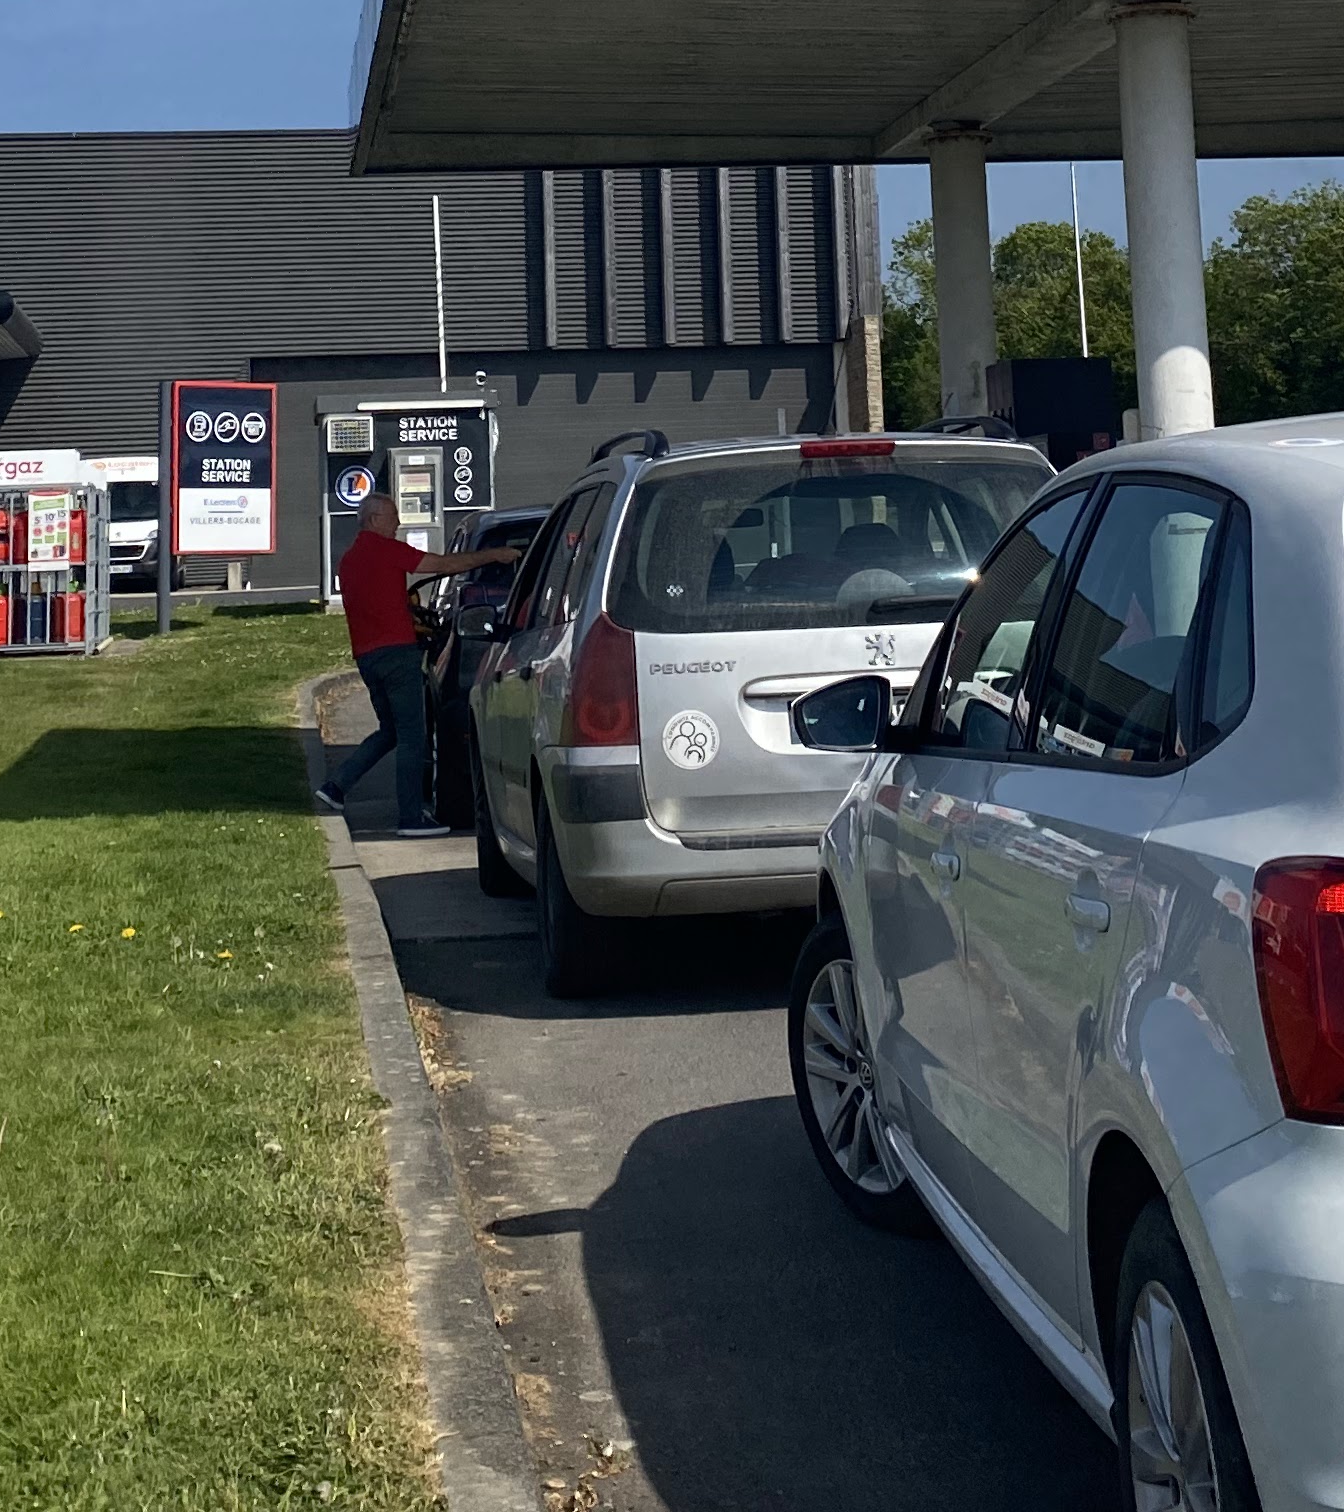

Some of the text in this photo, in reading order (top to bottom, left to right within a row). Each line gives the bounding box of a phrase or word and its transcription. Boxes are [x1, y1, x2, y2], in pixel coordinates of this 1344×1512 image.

[399, 415, 458, 429] STATION
[399, 428, 458, 442] SERVICE
[201, 458, 251, 470] STATION
[201, 471, 250, 483] SERVICE
[649, 660, 737, 676] PEUGEOT
